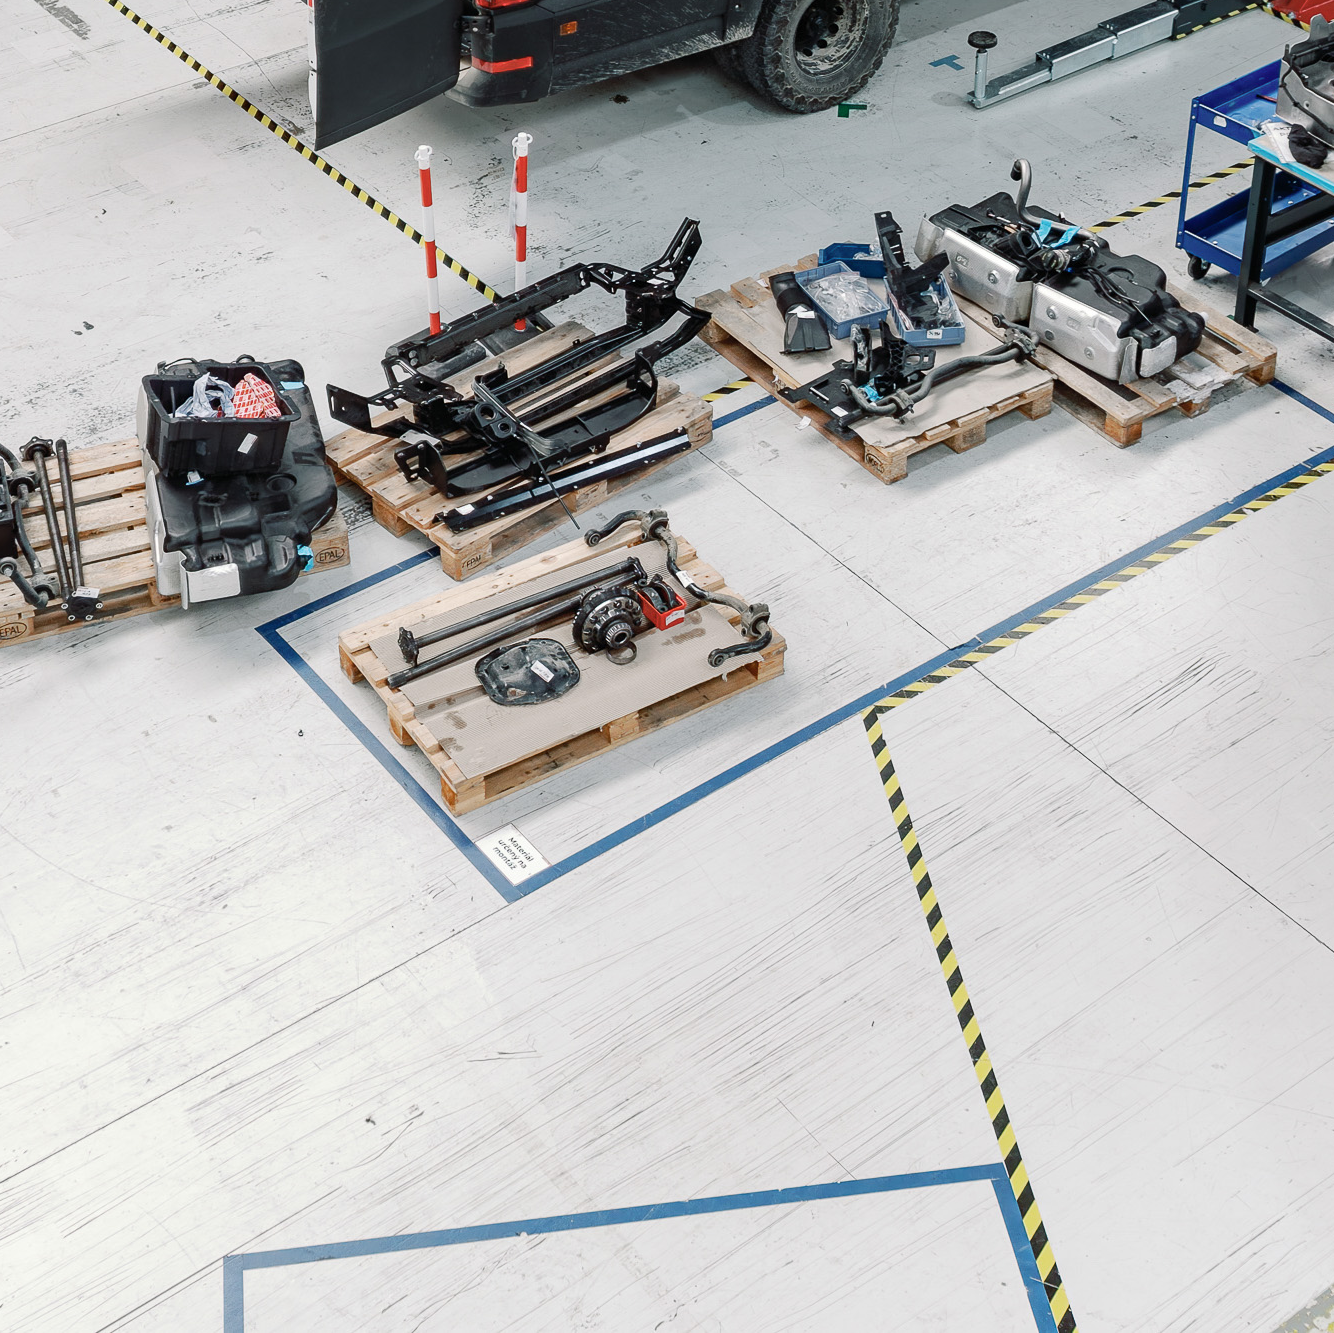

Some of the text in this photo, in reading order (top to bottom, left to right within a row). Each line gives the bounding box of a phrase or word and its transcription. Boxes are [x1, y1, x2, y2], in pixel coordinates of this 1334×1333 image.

[318, 549, 342, 562] EPAL
[492, 846, 517, 870] montáž
[498, 839, 527, 869] určený na
[508, 836, 535, 863] Materiál
